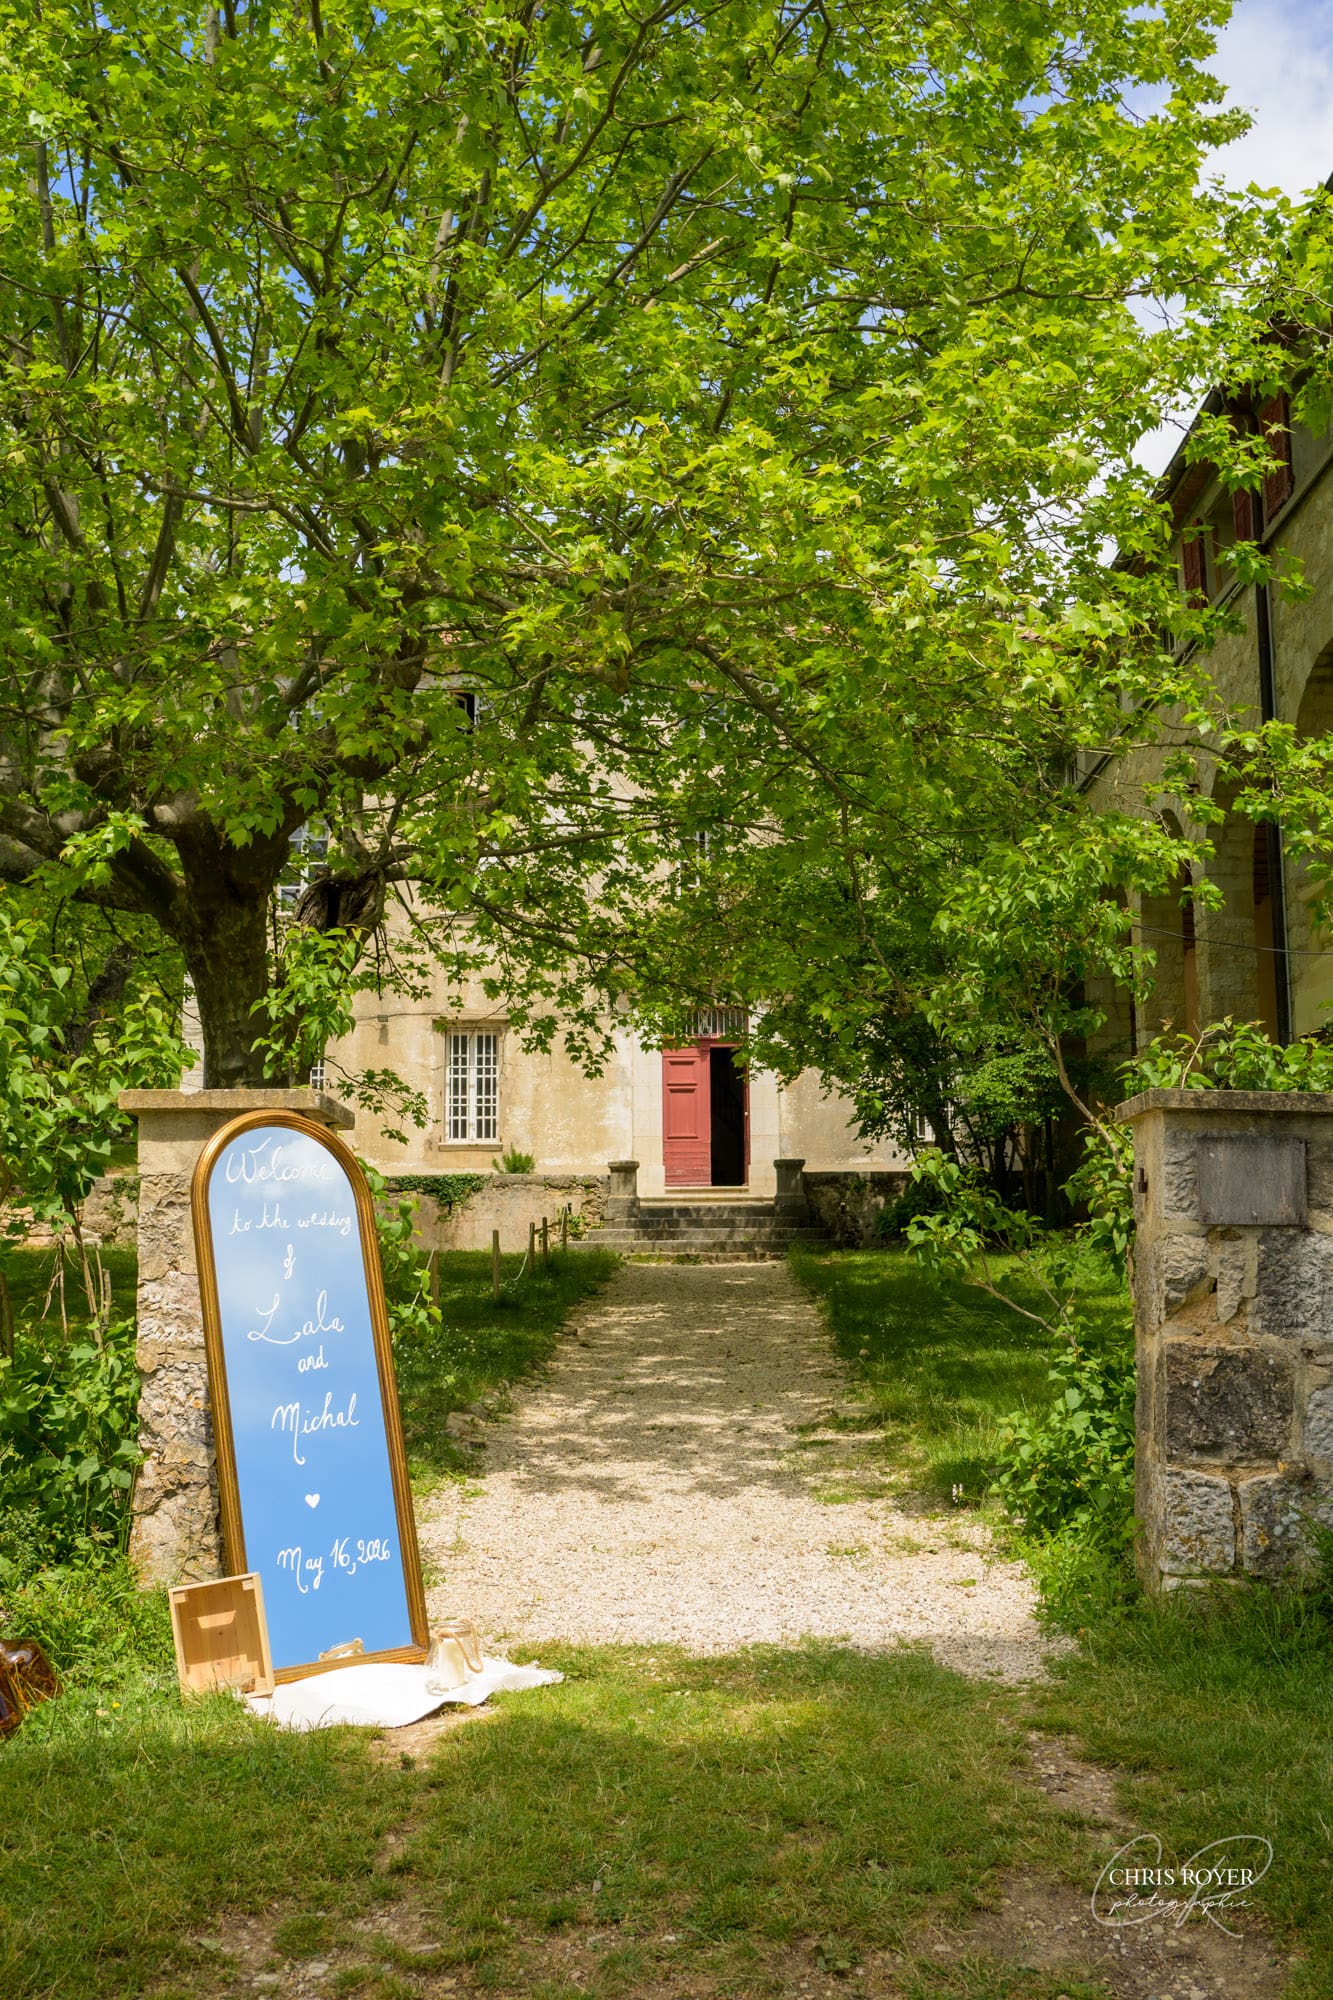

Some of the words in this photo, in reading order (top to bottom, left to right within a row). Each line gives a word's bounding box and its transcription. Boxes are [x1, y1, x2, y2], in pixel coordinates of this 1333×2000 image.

[224, 1207, 252, 1235] to
[255, 1200, 290, 1229] the
[247, 1289, 345, 1345] Lala
[297, 1344, 329, 1374] and
[271, 1391, 360, 1466] Michal
[276, 1546, 325, 1594] May
